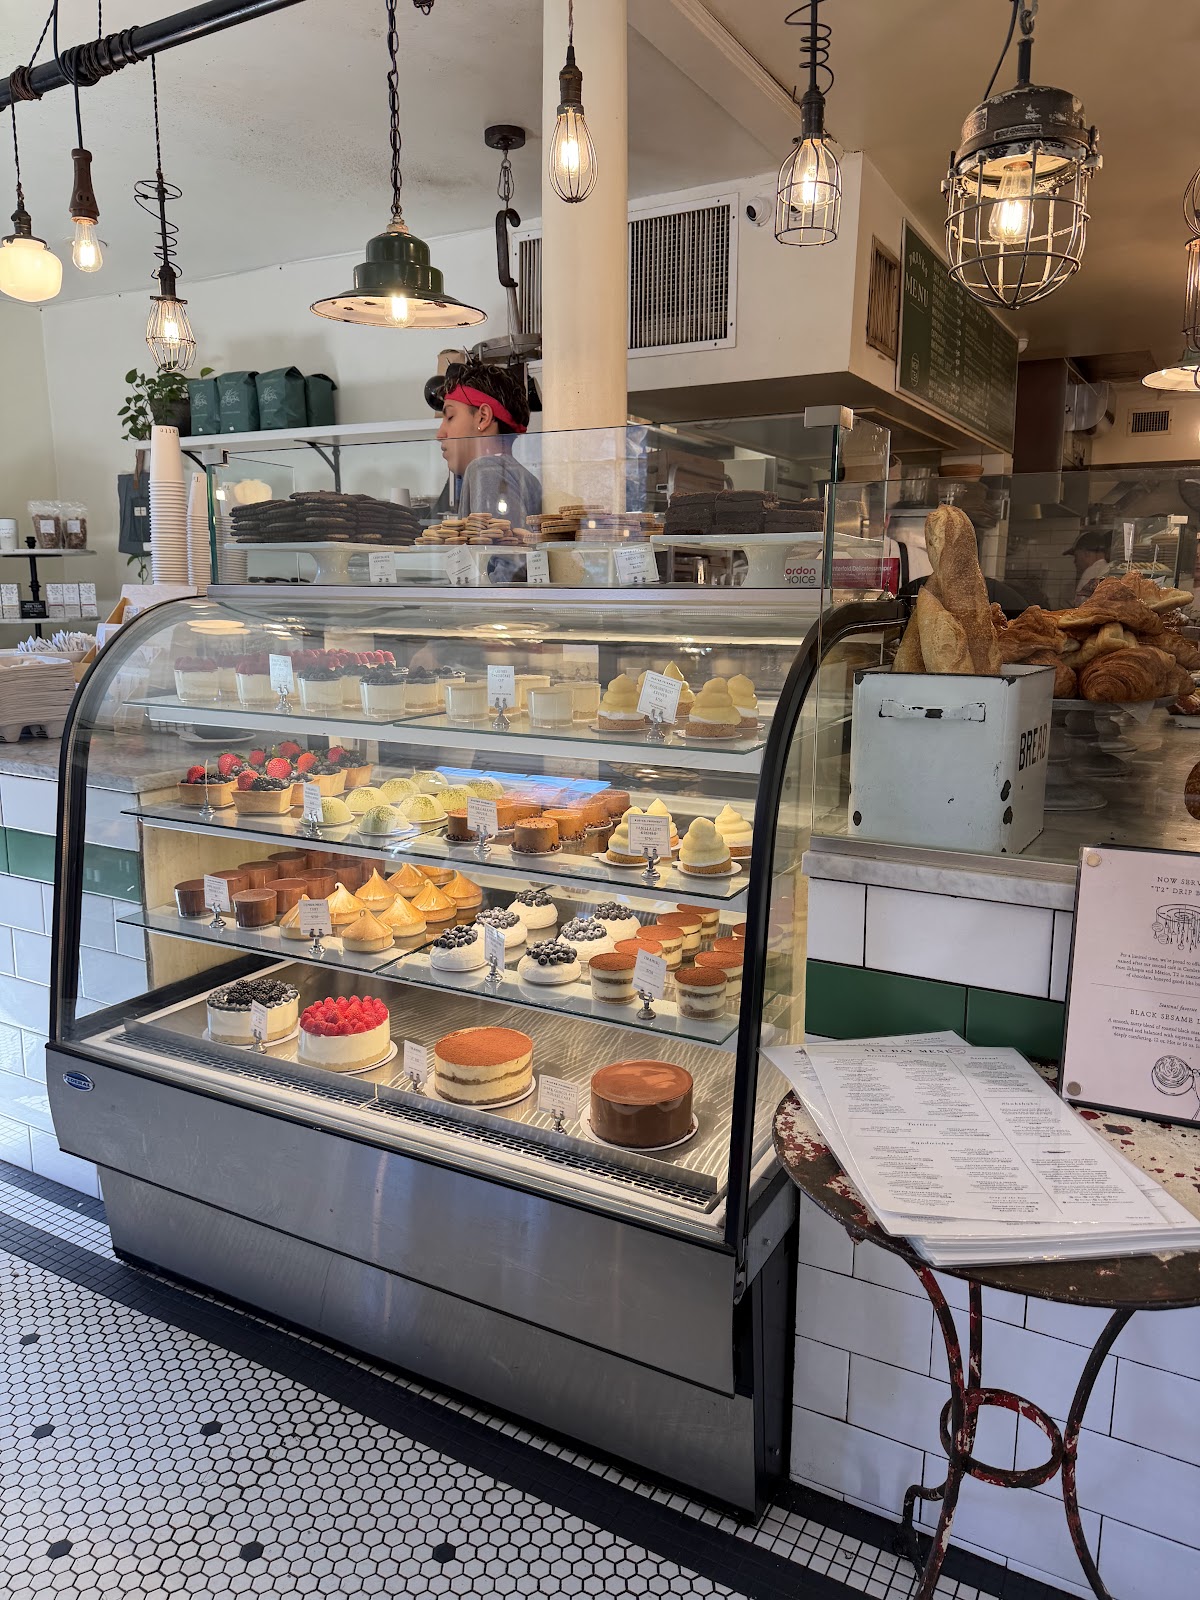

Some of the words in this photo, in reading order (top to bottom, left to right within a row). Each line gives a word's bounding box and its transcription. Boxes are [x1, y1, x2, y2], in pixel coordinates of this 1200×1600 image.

[905, 271, 929, 307] MENU
[785, 566, 816, 575] ordon
[1019, 723, 1048, 771] BREAD
[1157, 876, 1177, 884] NOW
[1172, 887, 1193, 896] DRIP
[1158, 1002, 1179, 1010] Seasonal
[1179, 1004, 1198, 1012] favorite
[1130, 1008, 1157, 1019] BLACK
[1160, 1013, 1194, 1024] SESAME
[1143, 1028, 1163, 1036] balanced
